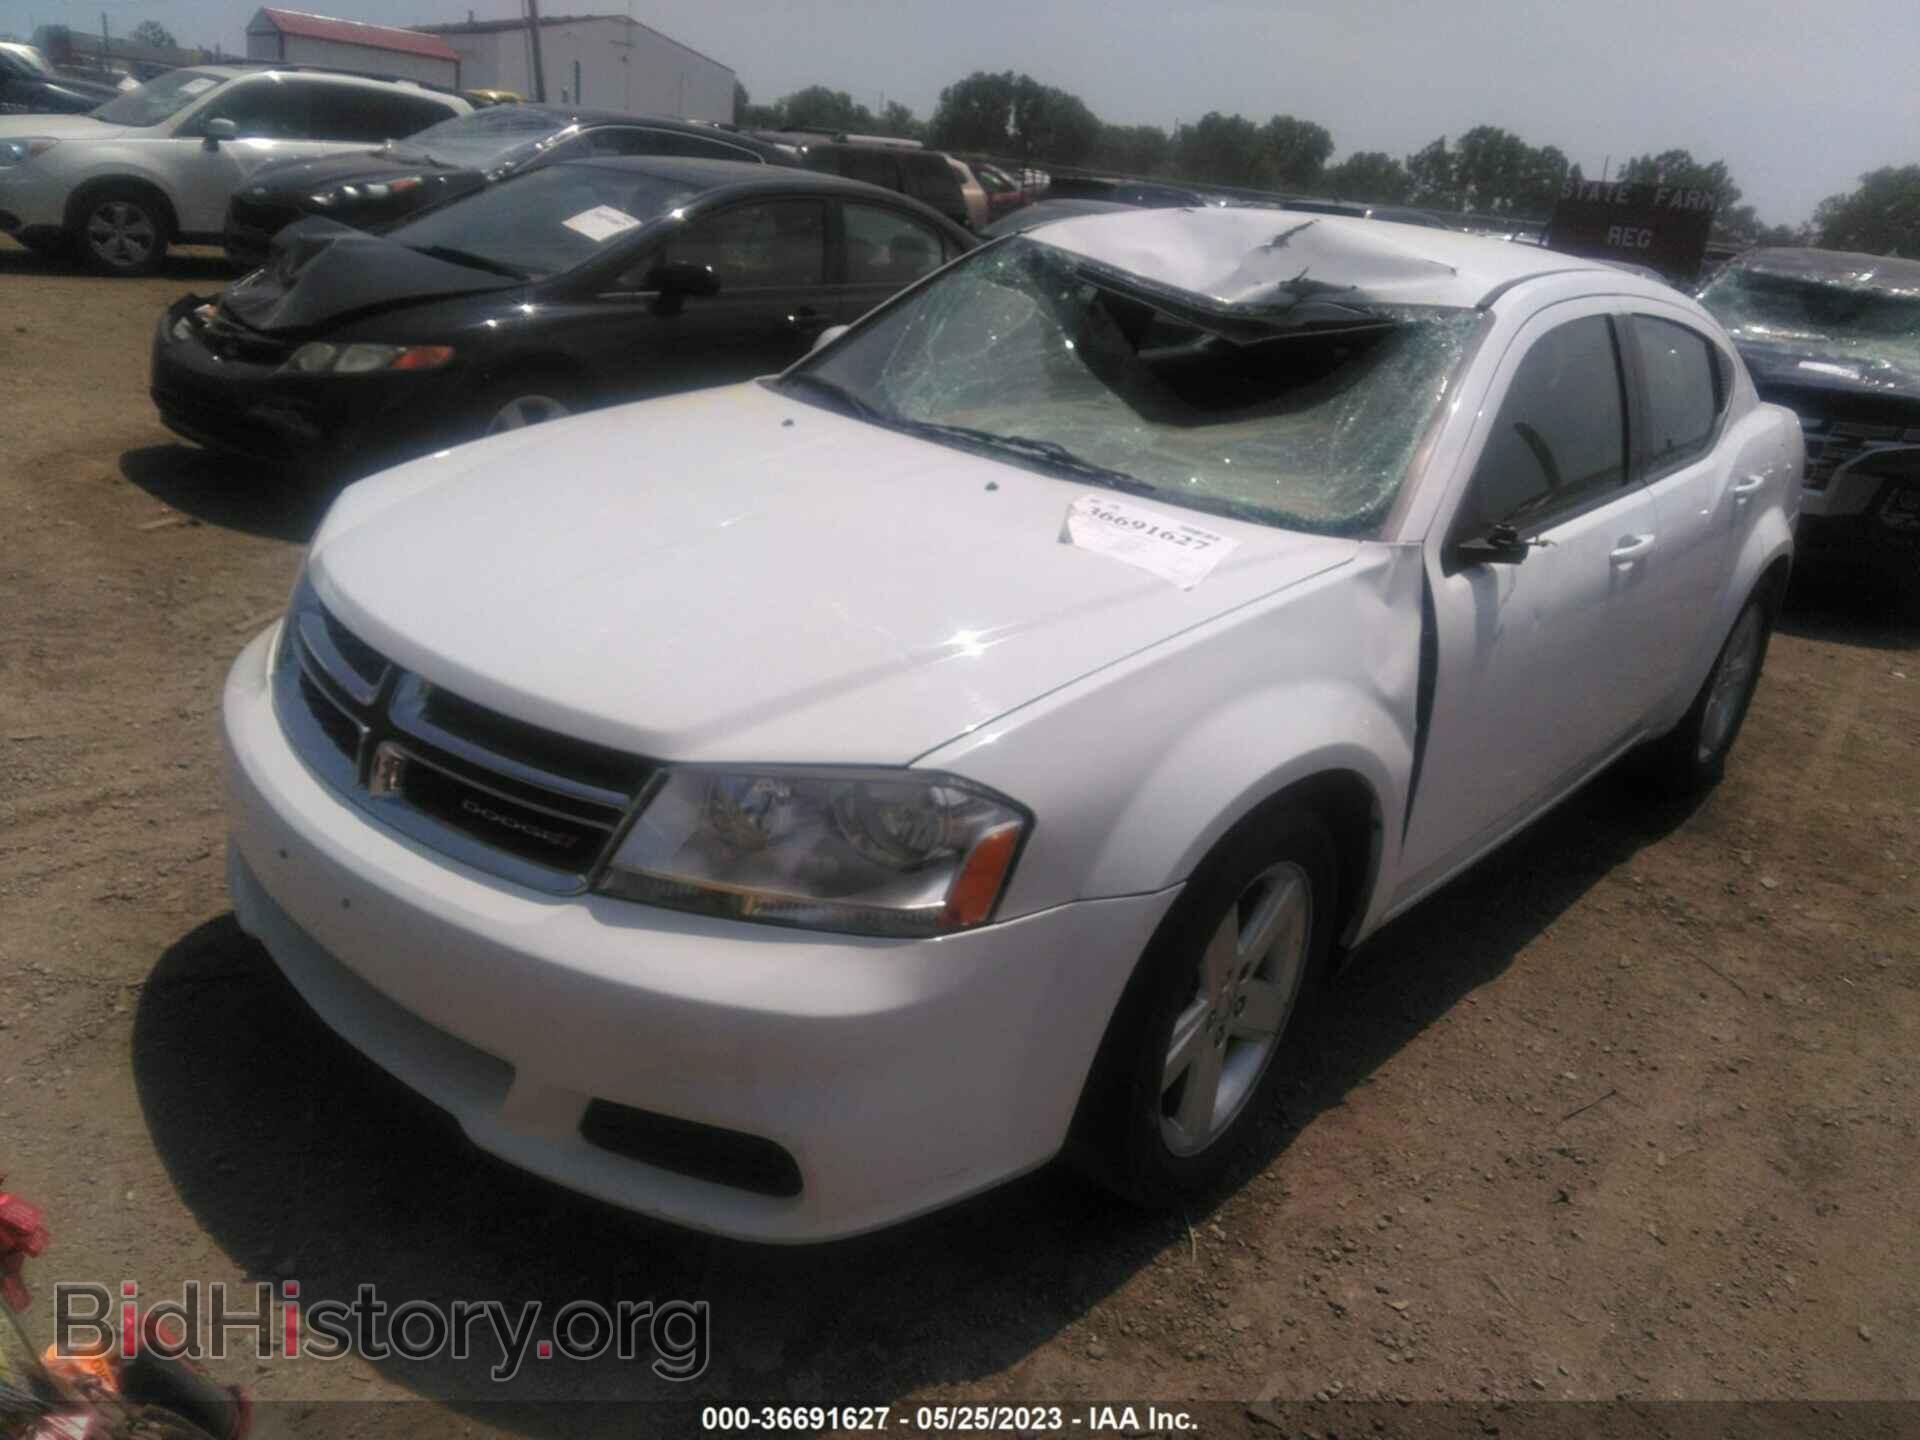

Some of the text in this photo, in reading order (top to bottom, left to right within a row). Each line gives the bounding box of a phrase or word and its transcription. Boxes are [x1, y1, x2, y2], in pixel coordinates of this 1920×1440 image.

[1560, 179, 1717, 211] STATE FARM
[1607, 225, 1653, 249] REG
